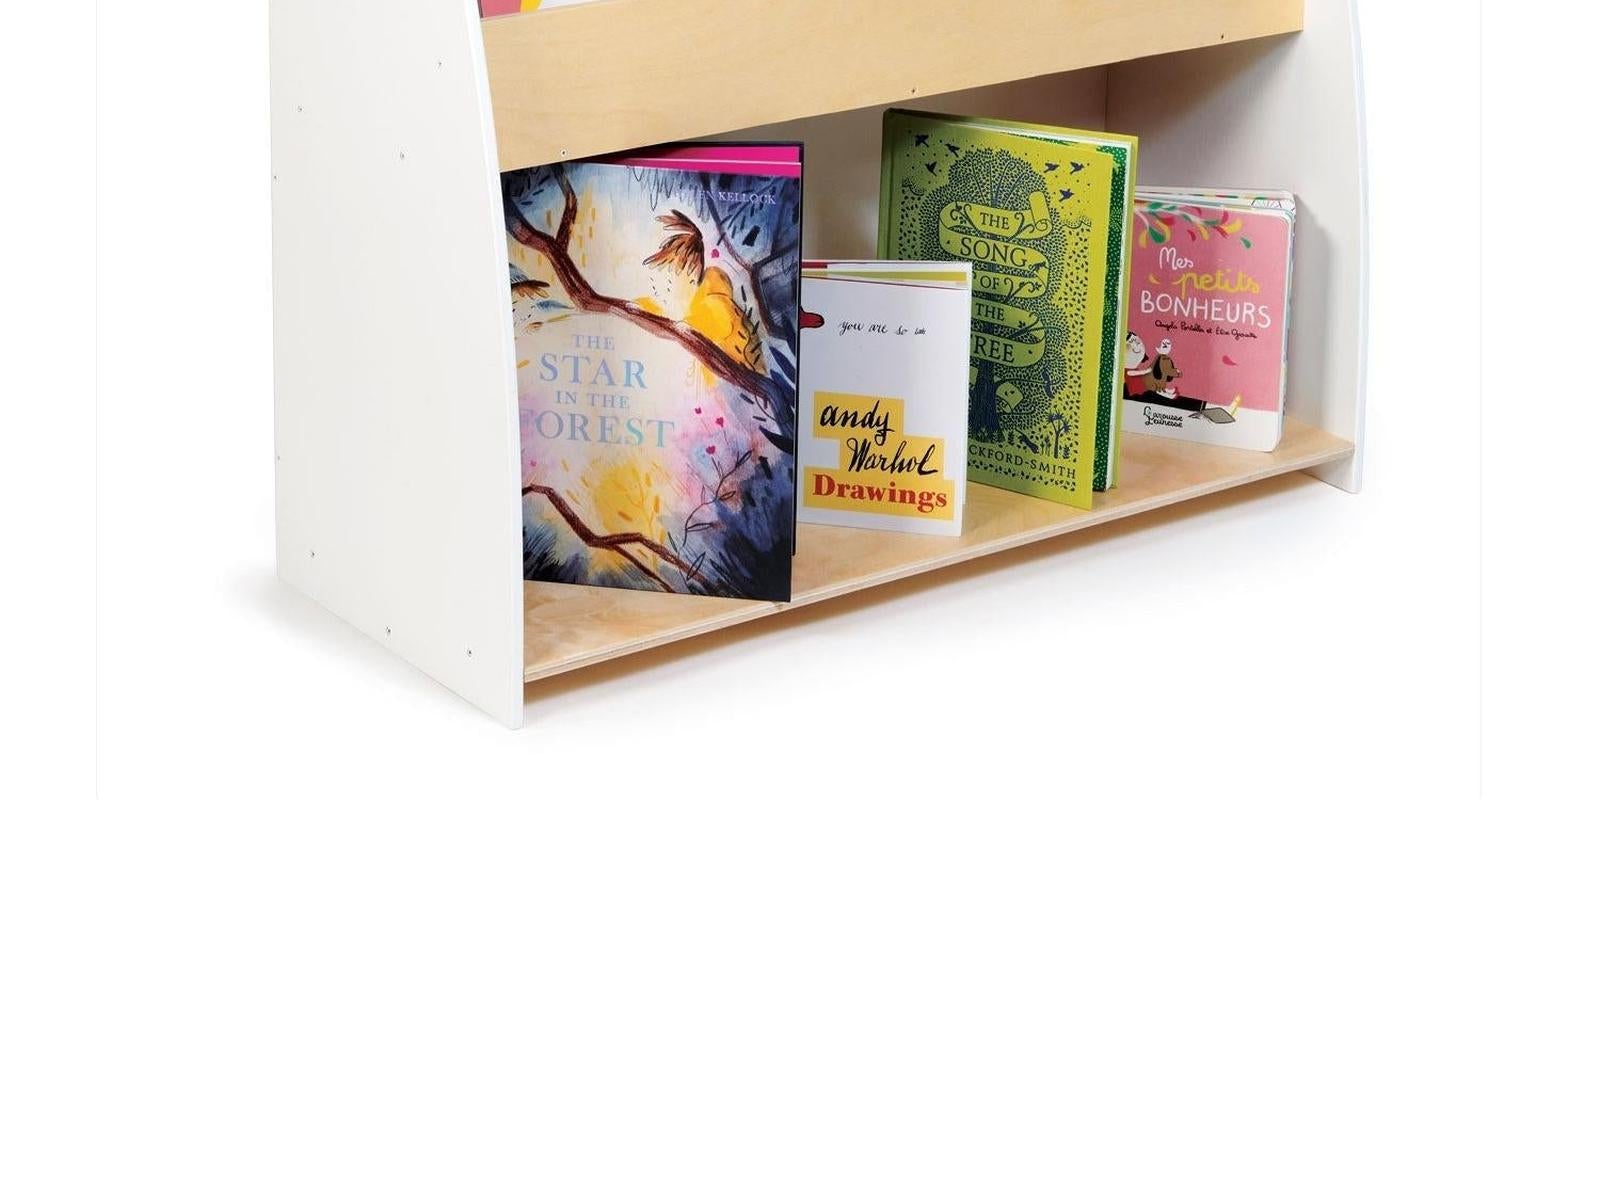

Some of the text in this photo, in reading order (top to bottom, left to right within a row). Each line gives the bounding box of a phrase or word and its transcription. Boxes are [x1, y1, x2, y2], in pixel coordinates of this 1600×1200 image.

[718, 191, 776, 205] KELLOCK
[979, 212, 1010, 231] THE
[960, 237, 1028, 268] SONG
[1160, 247, 1194, 270] Mes
[979, 276, 1000, 290] OF
[1172, 269, 1261, 298] petits
[975, 303, 1005, 322] THE
[1140, 290, 1272, 329] BONHEURS
[839, 321, 865, 336] you
[868, 323, 888, 334] are
[572, 333, 616, 351] THE
[971, 336, 1015, 364] REE
[539, 352, 648, 390] STAR
[555, 391, 630, 409] IN THE
[819, 400, 895, 446] andy
[847, 438, 938, 476] Warhol
[813, 474, 948, 513] Drawings
